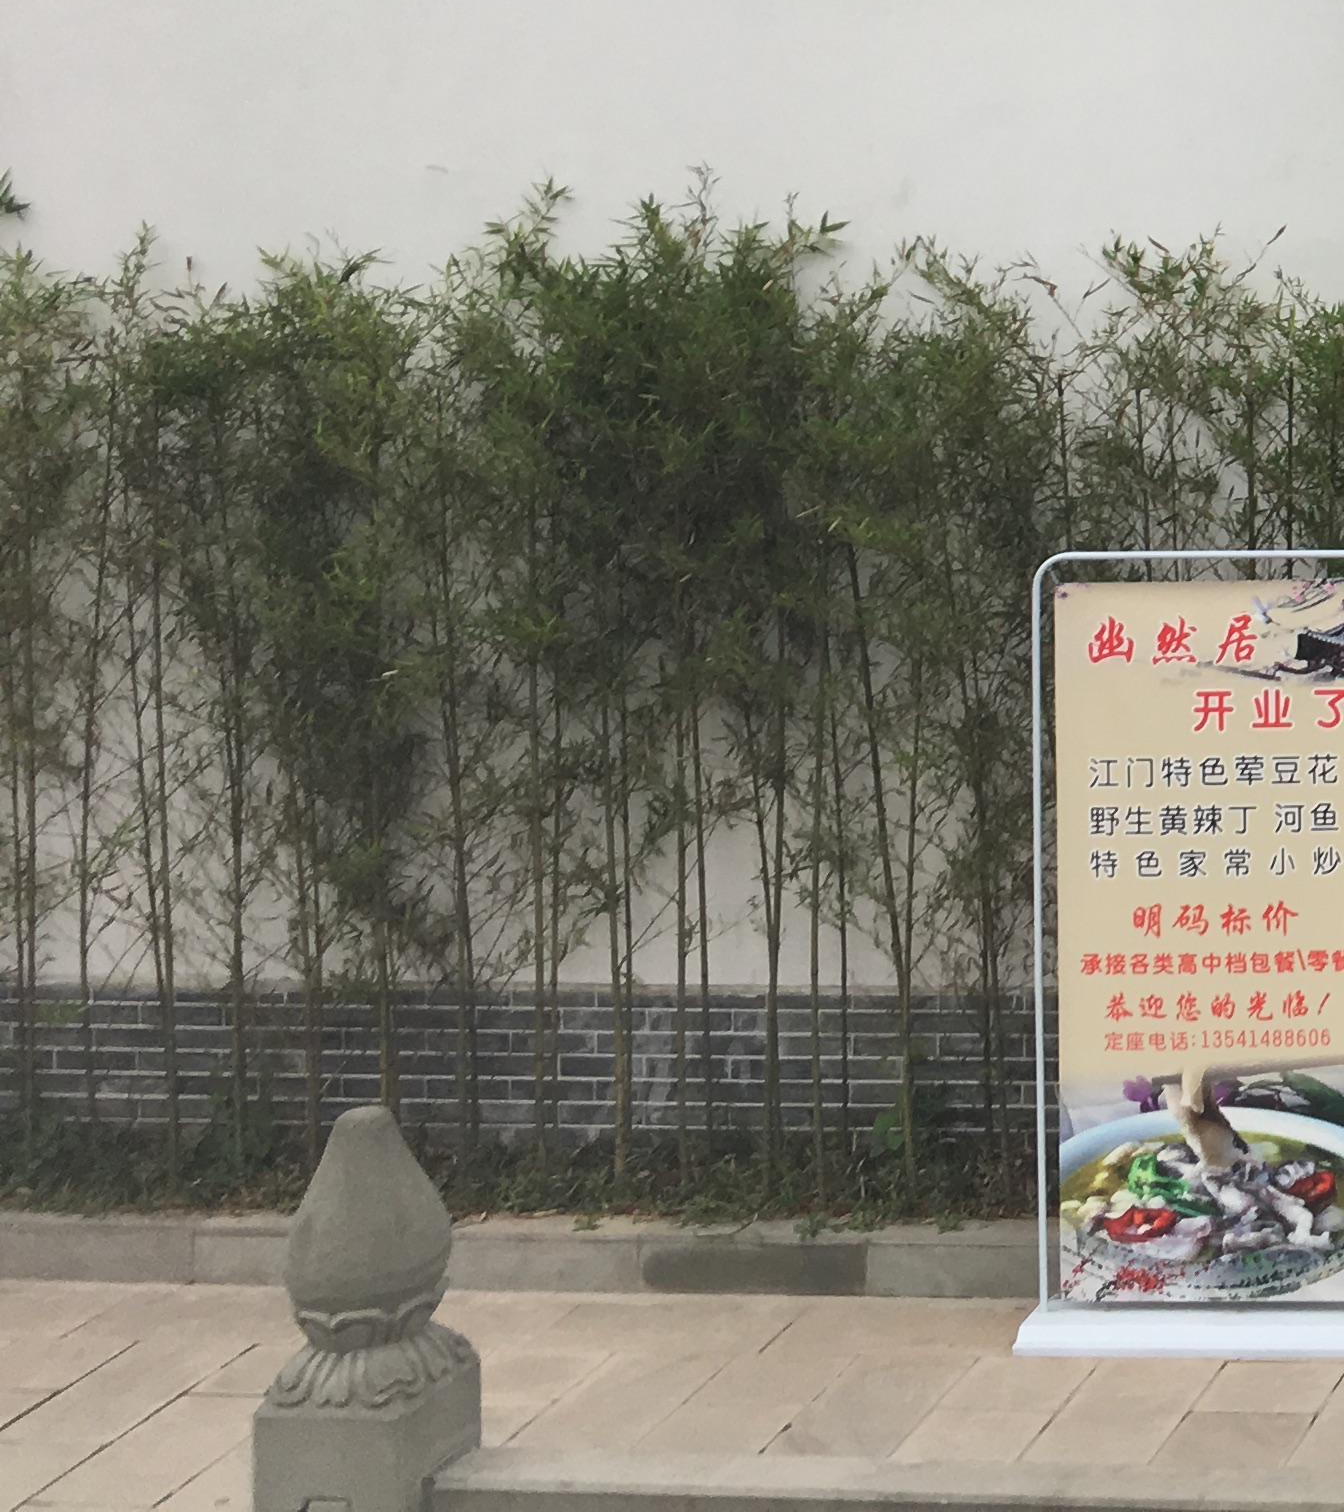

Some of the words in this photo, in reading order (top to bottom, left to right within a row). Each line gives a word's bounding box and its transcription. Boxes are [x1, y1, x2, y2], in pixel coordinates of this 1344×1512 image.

[1087, 613, 1259, 666] 幽然居
[1088, 754, 1340, 788] 江门特色荤豆花
[1090, 847, 1342, 878] 特色家常小炒
[1132, 899, 1300, 938] 明码标价
